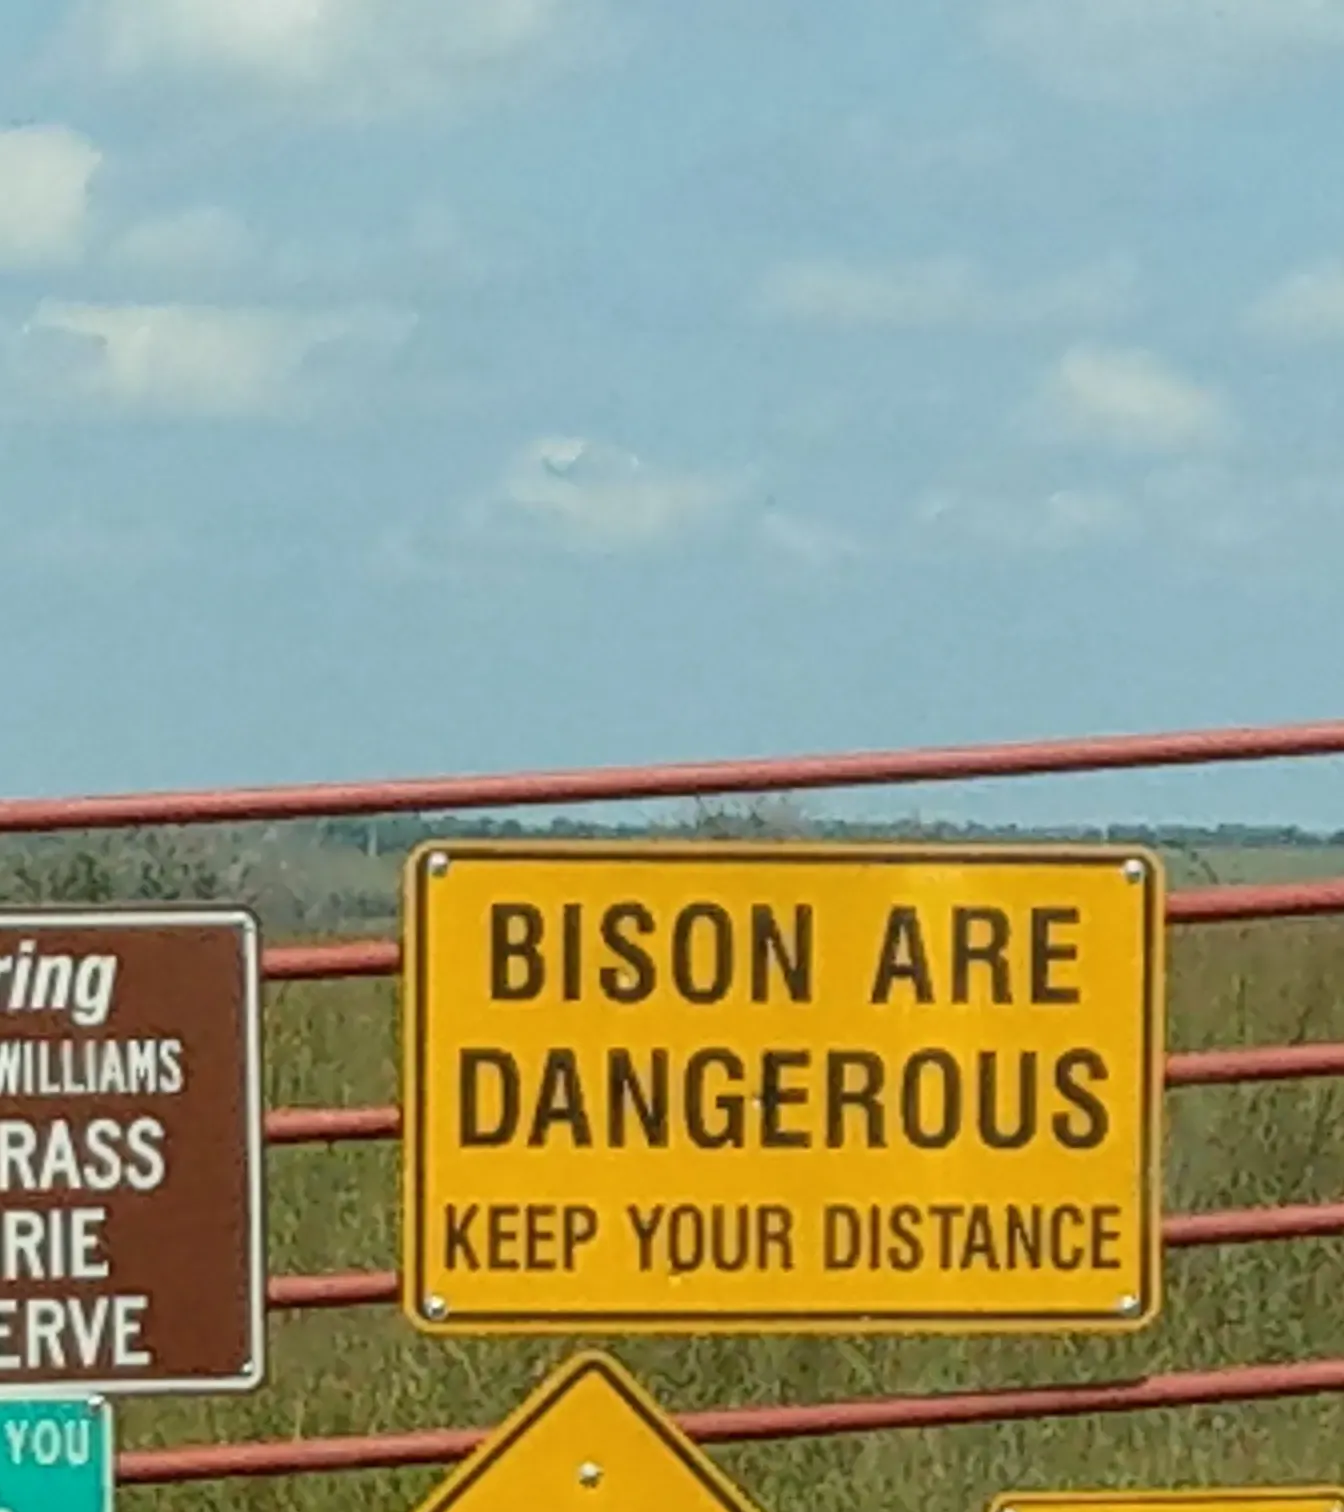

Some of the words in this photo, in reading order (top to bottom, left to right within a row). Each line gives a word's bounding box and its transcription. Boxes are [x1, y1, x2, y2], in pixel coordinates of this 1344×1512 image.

[489, 902, 813, 1005] BISON
[871, 906, 1081, 1005] ARE
[458, 1048, 1110, 1150] DANGEROUS
[444, 1203, 598, 1272] KEEP
[628, 1203, 794, 1273] YOUR
[824, 1203, 1123, 1272] DISTANCE
[5, 1419, 90, 1466] YOU
